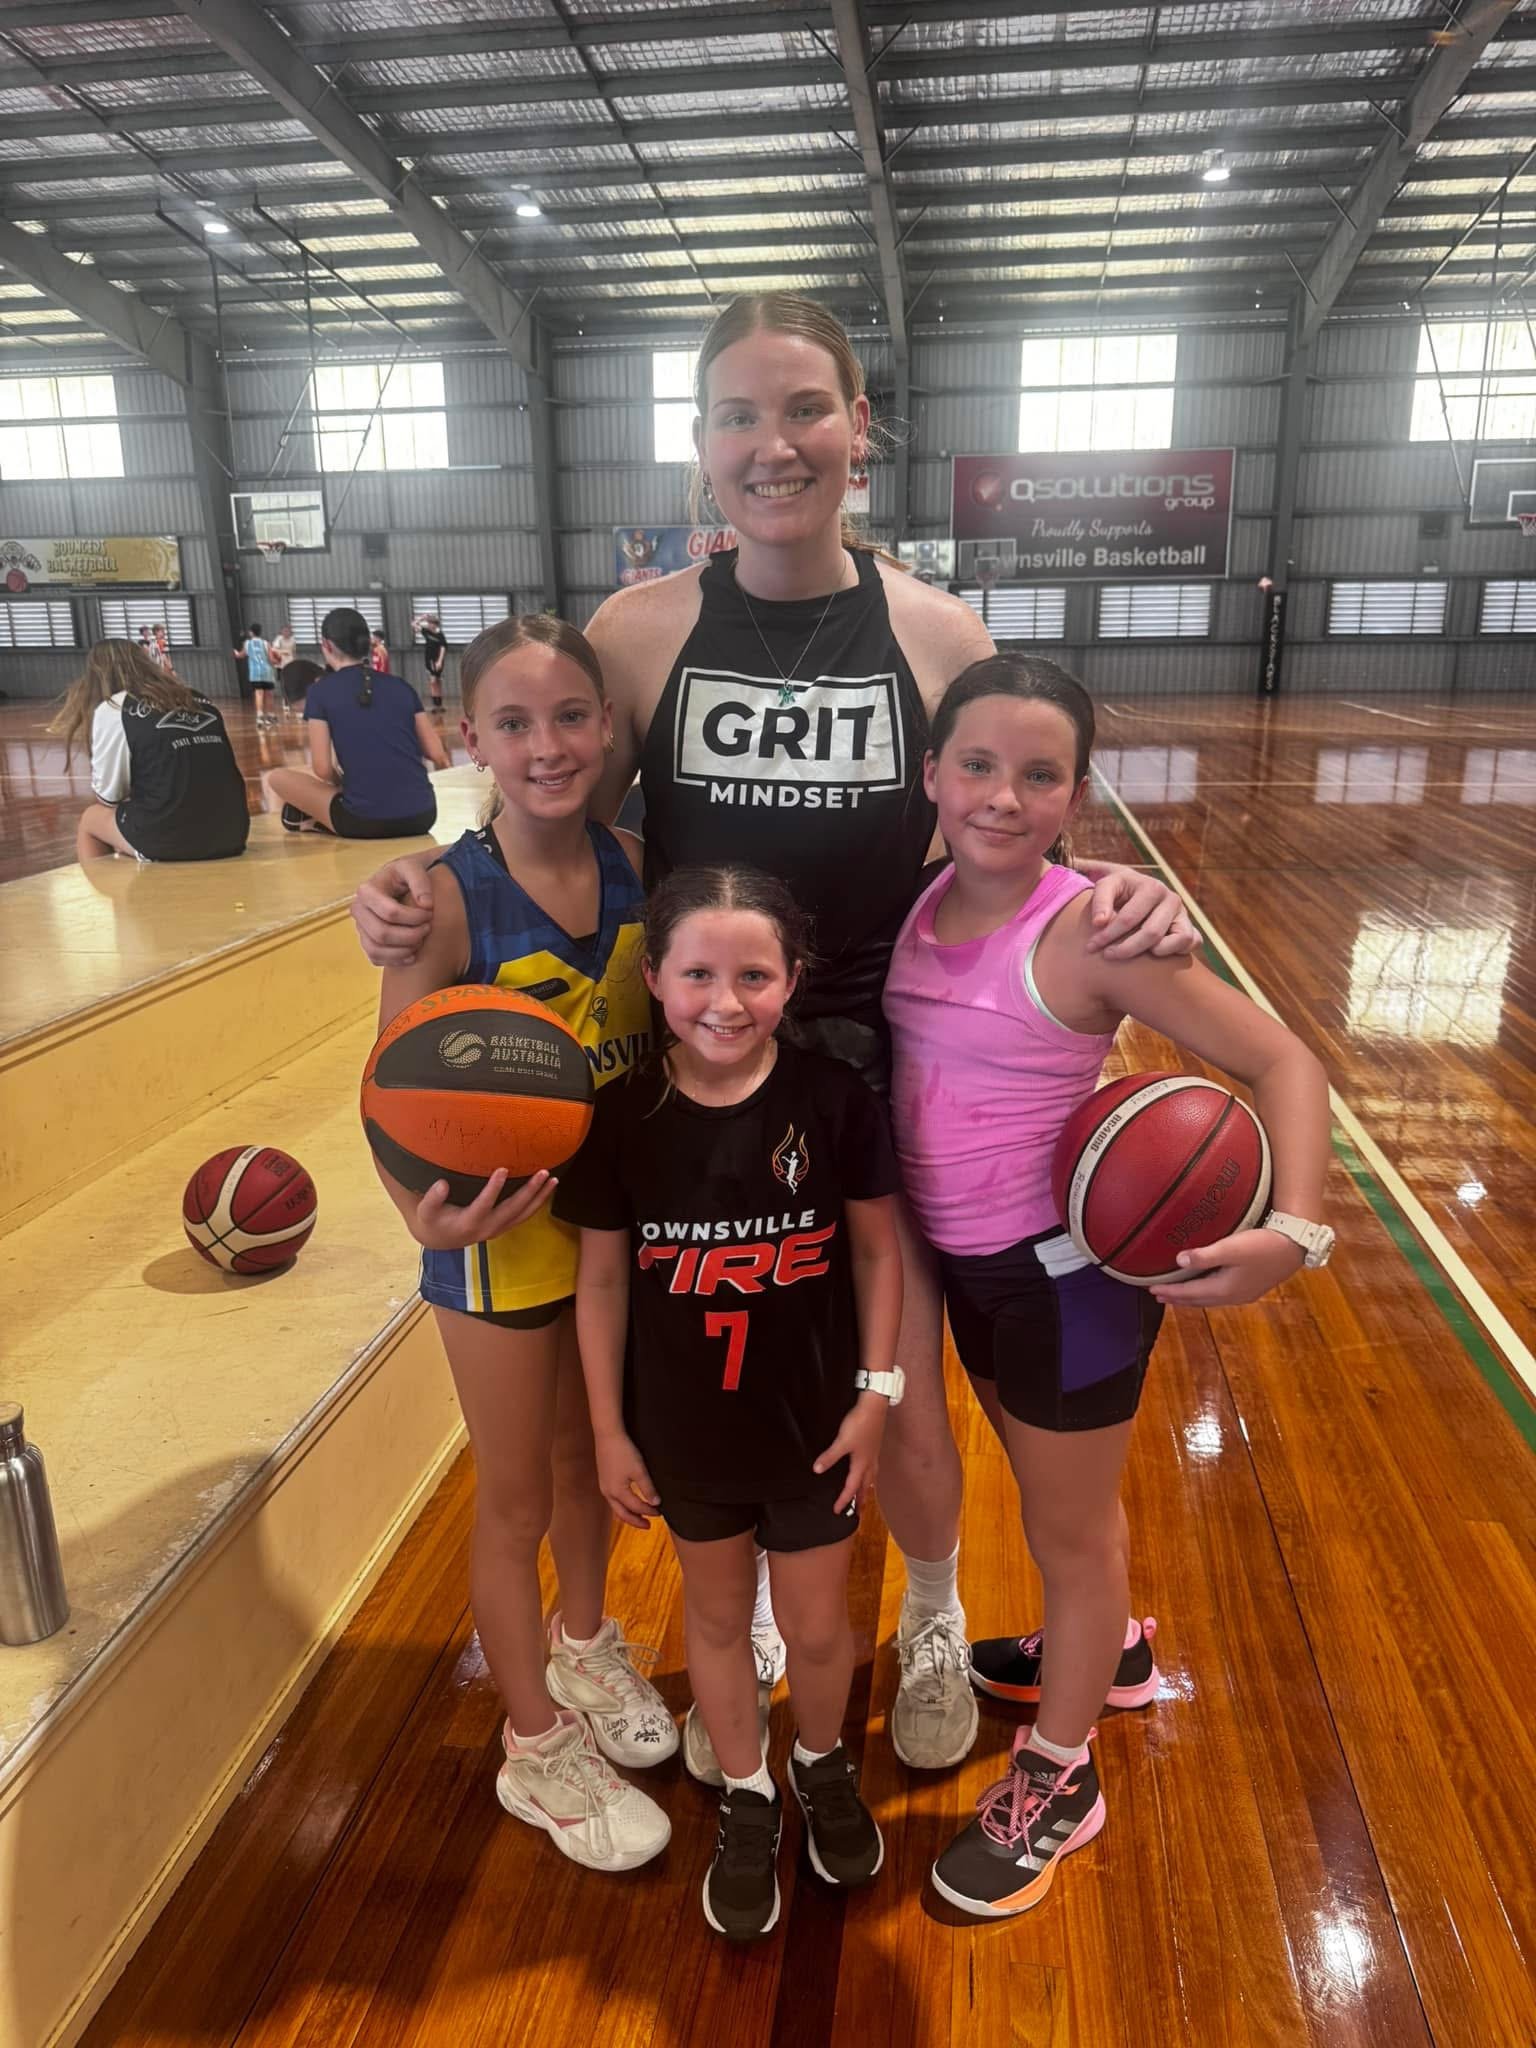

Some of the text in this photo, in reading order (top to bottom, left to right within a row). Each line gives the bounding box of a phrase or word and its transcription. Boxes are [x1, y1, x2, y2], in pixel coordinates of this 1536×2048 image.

[1164, 496, 1214, 511] group
[1031, 517, 1153, 540] Proudly Supports
[47, 557, 119, 574] BASKETBALL
[1093, 543, 1206, 567] Basketball
[702, 701, 876, 761] GRIT
[709, 782, 864, 809] MINDSET
[490, 1035, 560, 1055] BASKETBALL
[490, 1048, 561, 1069] AUSTRALIA
[1166, 1158, 1241, 1246] molten
[637, 1209, 815, 1241] OWNSVILLE
[705, 1310, 749, 1391] 7
